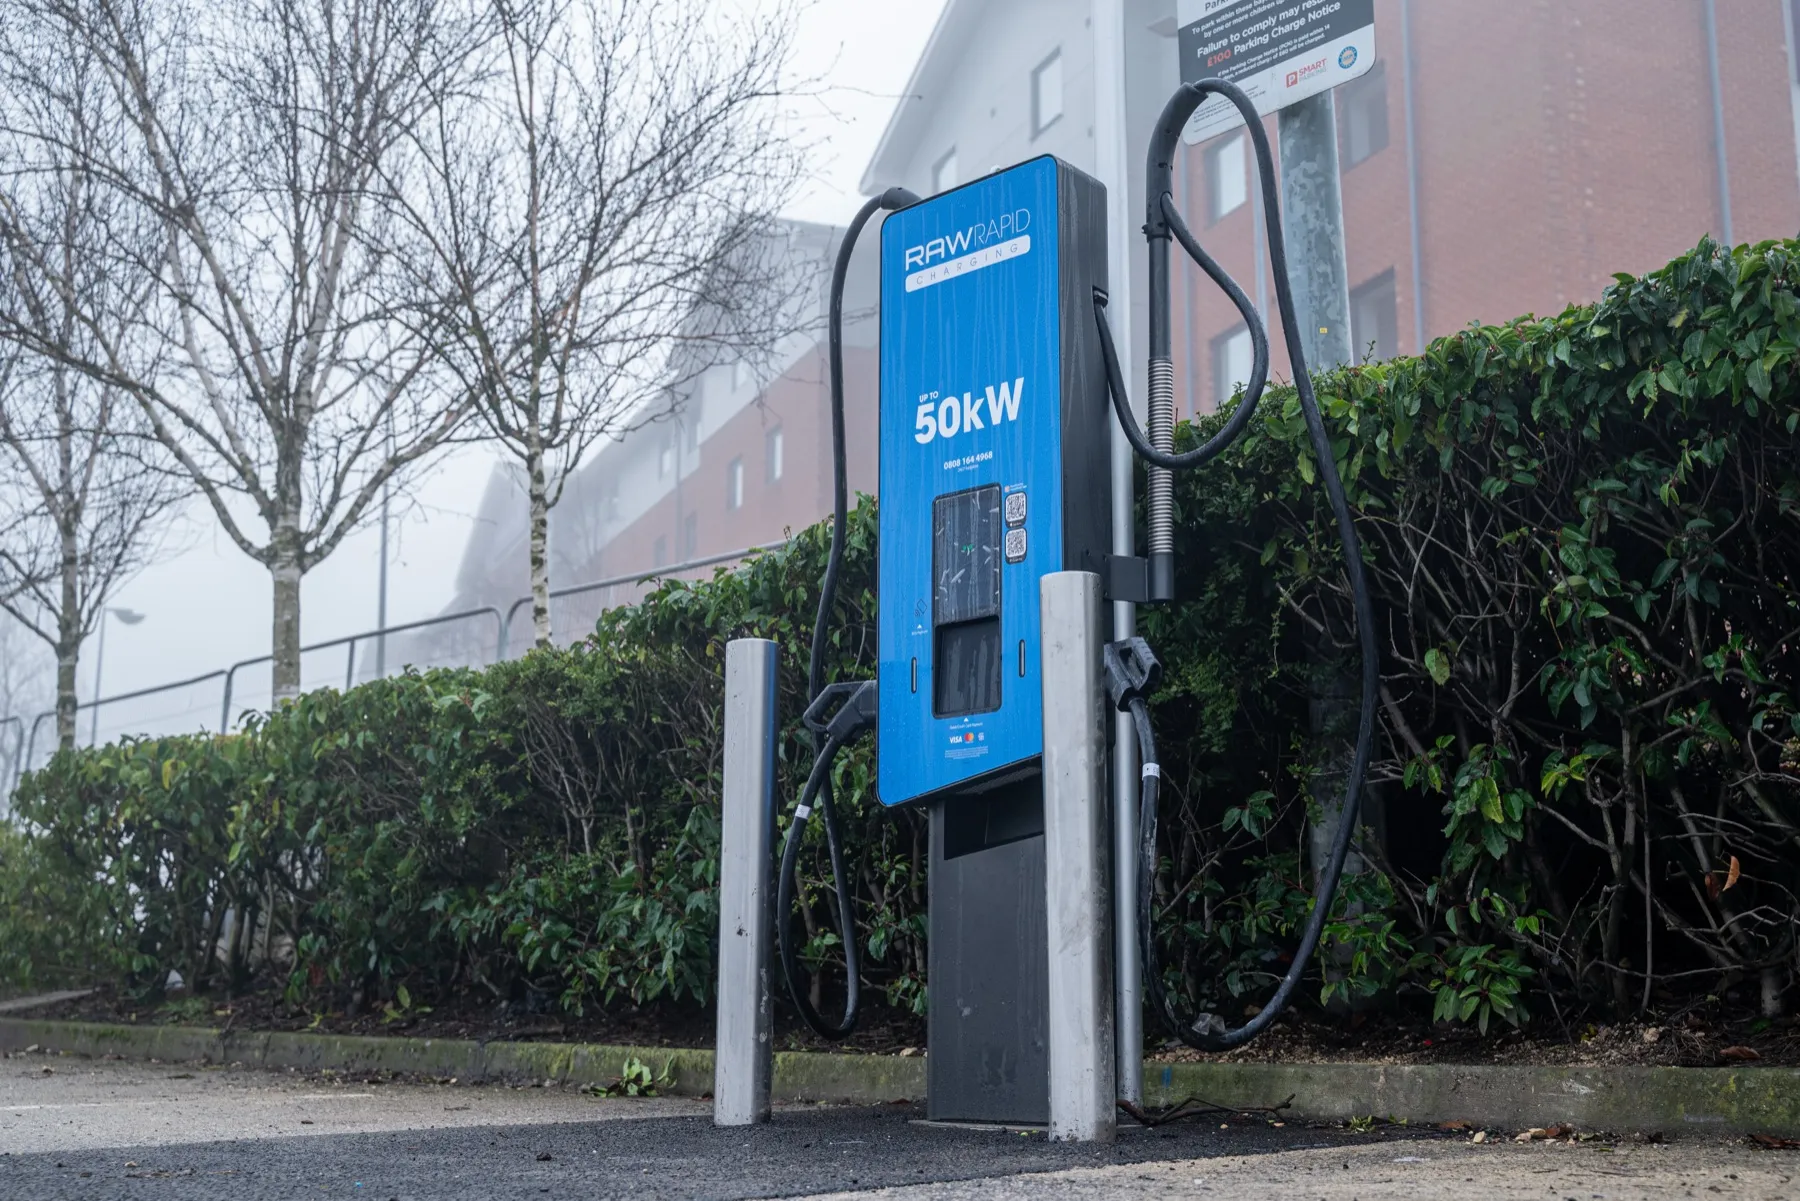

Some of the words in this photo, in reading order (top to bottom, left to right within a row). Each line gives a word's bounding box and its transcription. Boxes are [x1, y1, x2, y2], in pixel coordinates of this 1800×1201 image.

[1192, 27, 1200, 35] To
[1201, 20, 1215, 32] park
[1216, 11, 1235, 24] within
[1236, 3, 1253, 15] these
[1197, 38, 1228, 58] Failure
[1230, 32, 1241, 43] to
[1242, 15, 1277, 37] comply
[1279, 5, 1300, 21] may
[1203, 30, 1212, 38] by
[1213, 25, 1225, 34] one
[1225, 21, 1232, 29] or
[1232, 13, 1249, 25] more
[1250, 1, 1275, 17] children
[1207, 49, 1232, 68] £100
[1234, 33, 1270, 56] Parking
[1271, 17, 1306, 38] Charge
[1308, 2, 1341, 23] Notice
[1229, 61, 1247, 73] Parking
[1246, 54, 1263, 65] Charge
[1298, 58, 1327, 77] SMART
[916, 243, 1018, 285] CHARGING
[914, 376, 1025, 445] 50kW
[919, 394, 929, 403] UP
[929, 390, 939, 400] TO
[943, 458, 961, 470] 0808
[962, 455, 975, 466] 164
[975, 450, 993, 462] 4968
[949, 735, 963, 744] VISA
